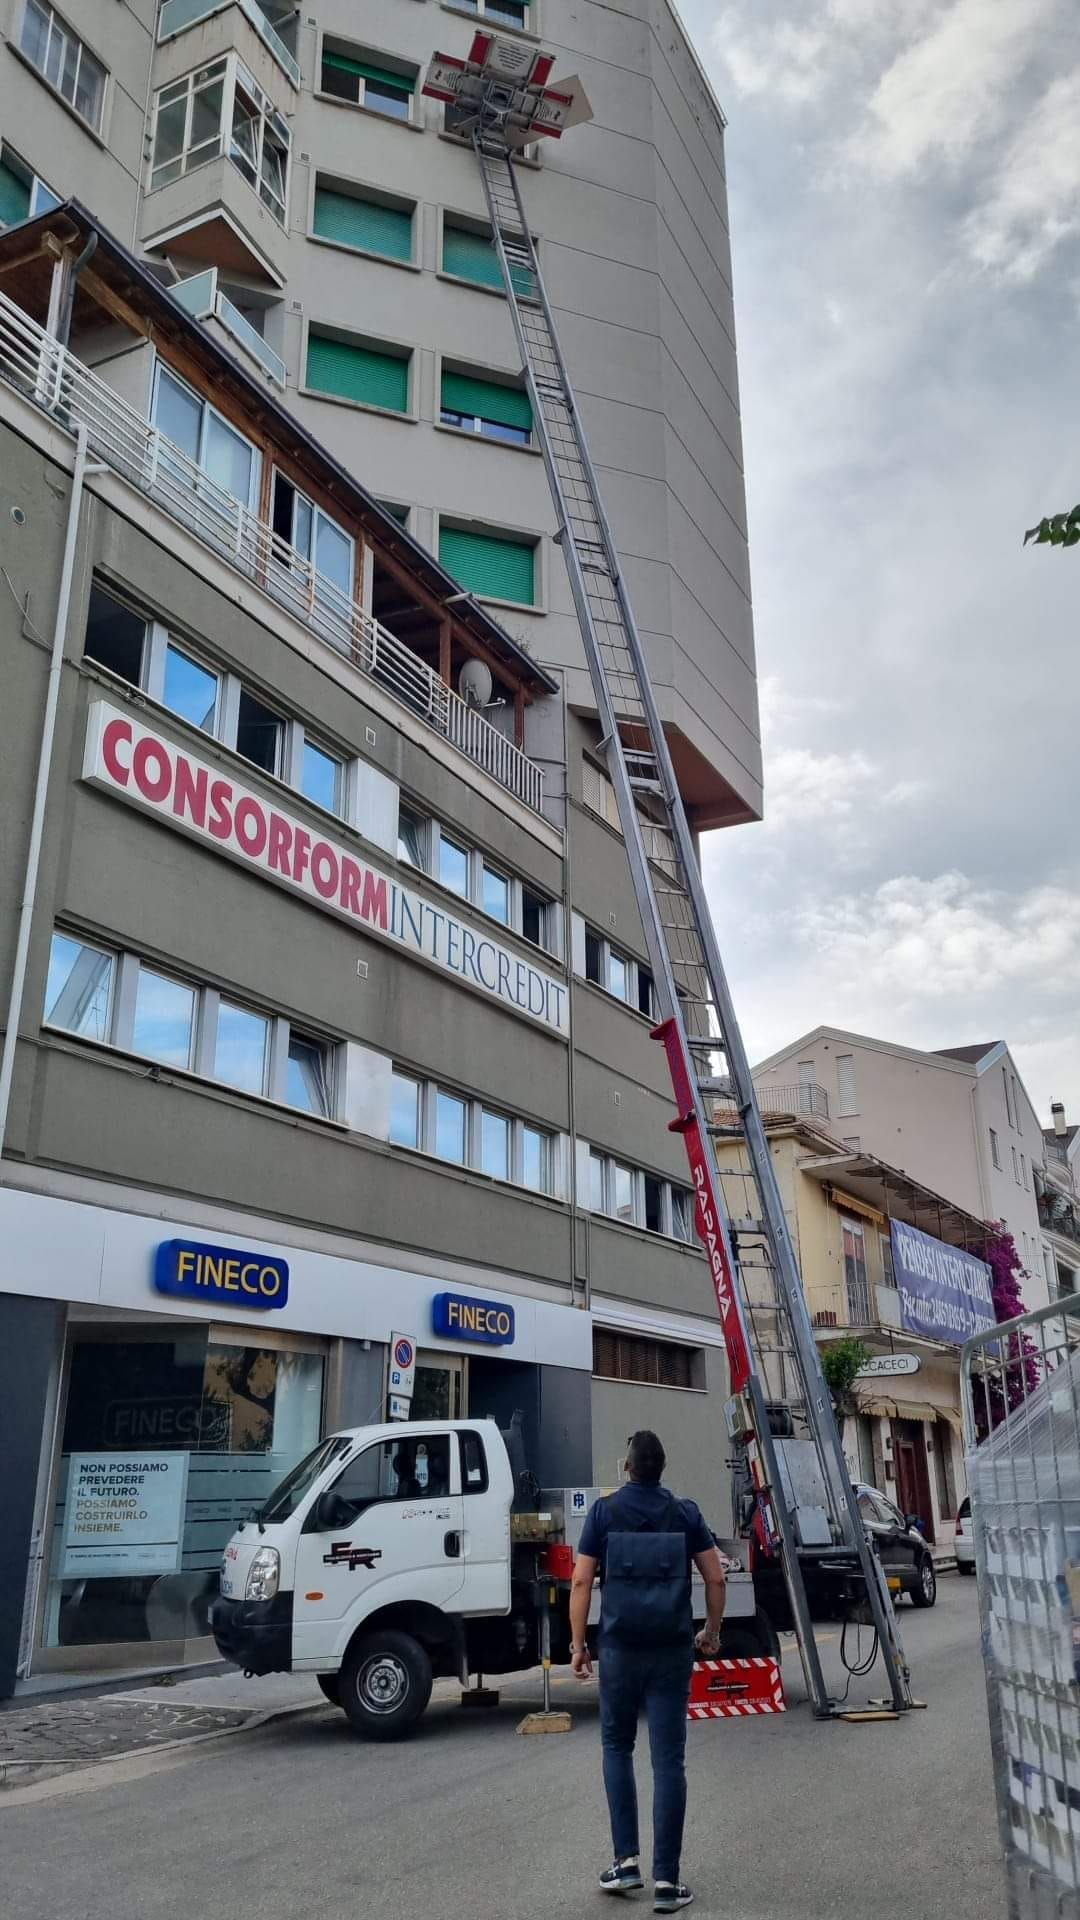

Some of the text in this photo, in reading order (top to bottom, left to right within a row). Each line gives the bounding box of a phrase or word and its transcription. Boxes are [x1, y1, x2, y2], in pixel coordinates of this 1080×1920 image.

[103, 719, 566, 1029] CONSORFORM INTERCREDIT
[177, 1250, 281, 1296] FINECO
[448, 1302, 510, 1336] FINECO
[80, 1463, 169, 1473] NON POSSIAMO
[78, 1475, 145, 1485] PREVEDERE
[77, 1487, 140, 1497] IL FUTURO.
[77, 1499, 137, 1509] POSSIAMO
[75, 1510, 148, 1521] COSTRUIRLO
[73, 1522, 124, 1533] INSIEME.
